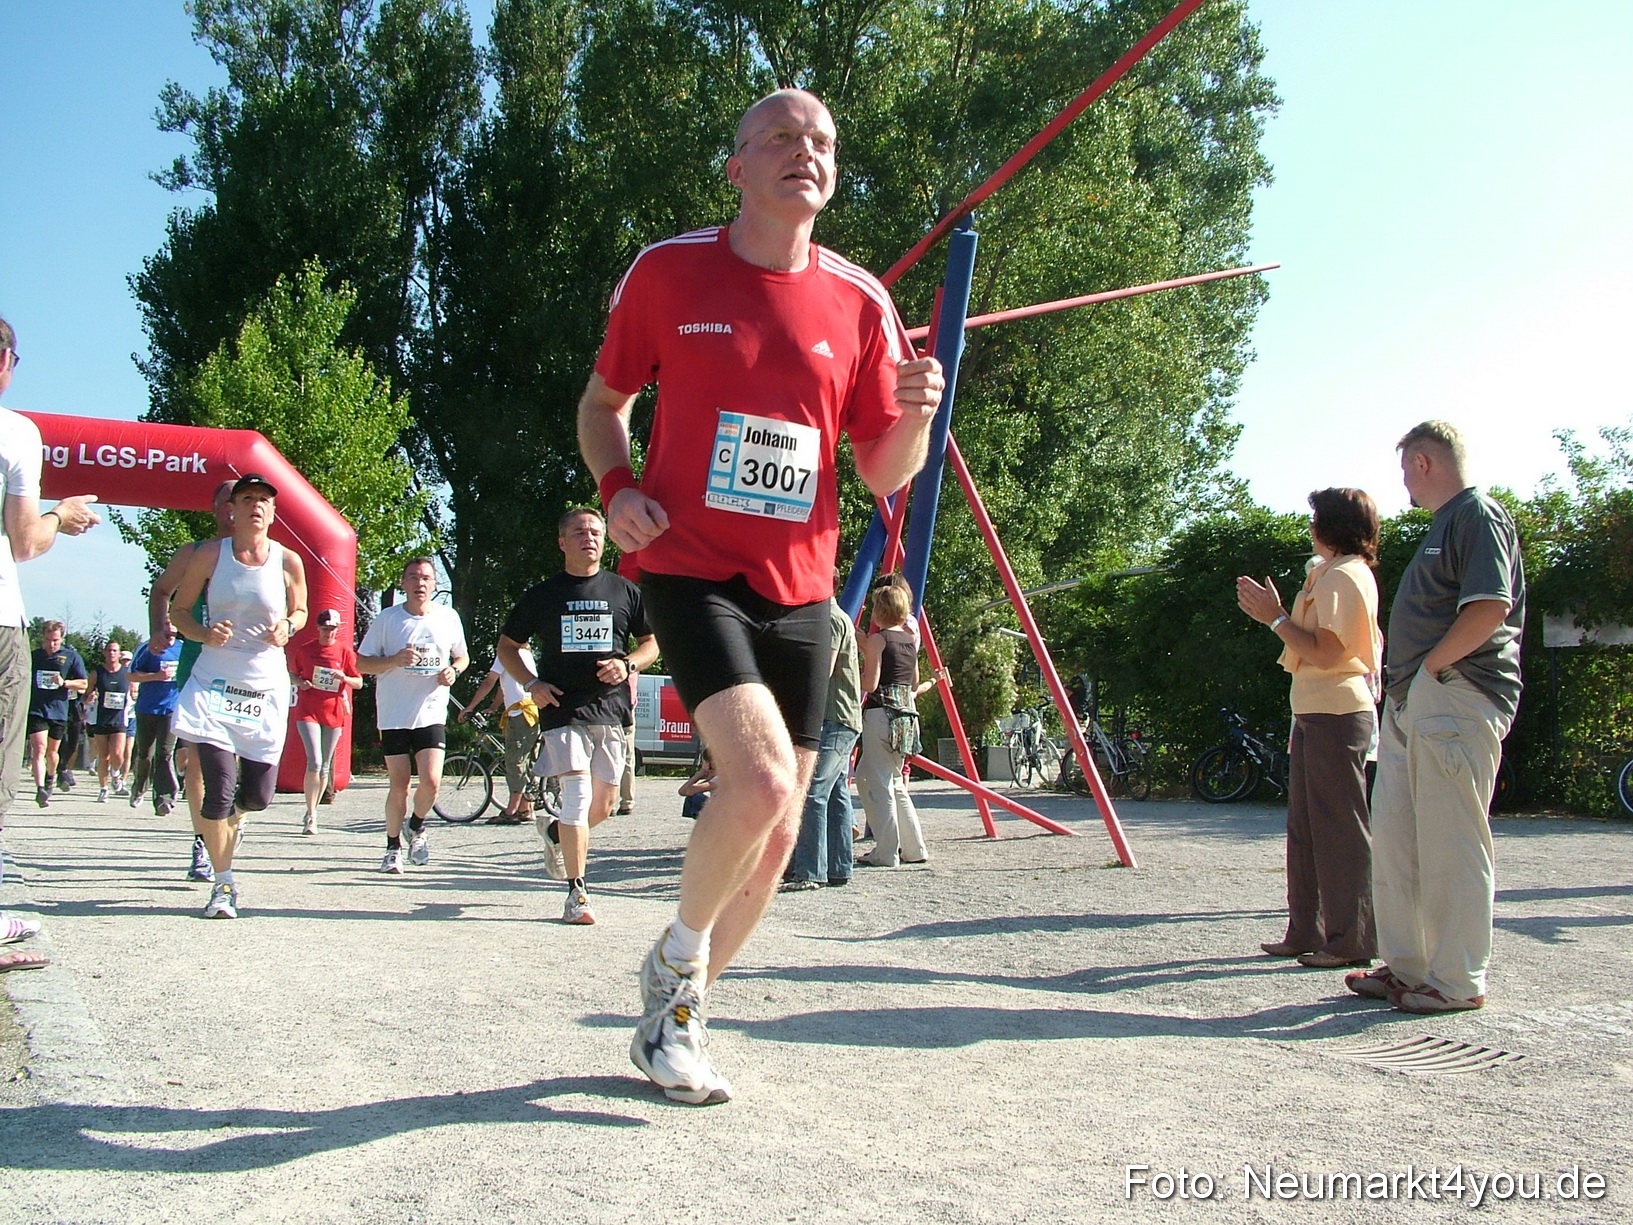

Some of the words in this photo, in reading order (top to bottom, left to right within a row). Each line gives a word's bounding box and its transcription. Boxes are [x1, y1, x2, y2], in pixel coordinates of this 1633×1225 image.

[677, 323, 732, 335] TOSHIBA
[744, 426, 797, 451] Johann
[78, 443, 207, 473] LGS-Park
[718, 448, 731, 463] C
[741, 458, 811, 494] 3007
[564, 625, 570, 633] C
[575, 627, 610, 640] 3447
[416, 657, 441, 667] 2388
[225, 685, 265, 700] Alexander
[224, 700, 262, 717] 3449
[660, 718, 690, 733] Braun
